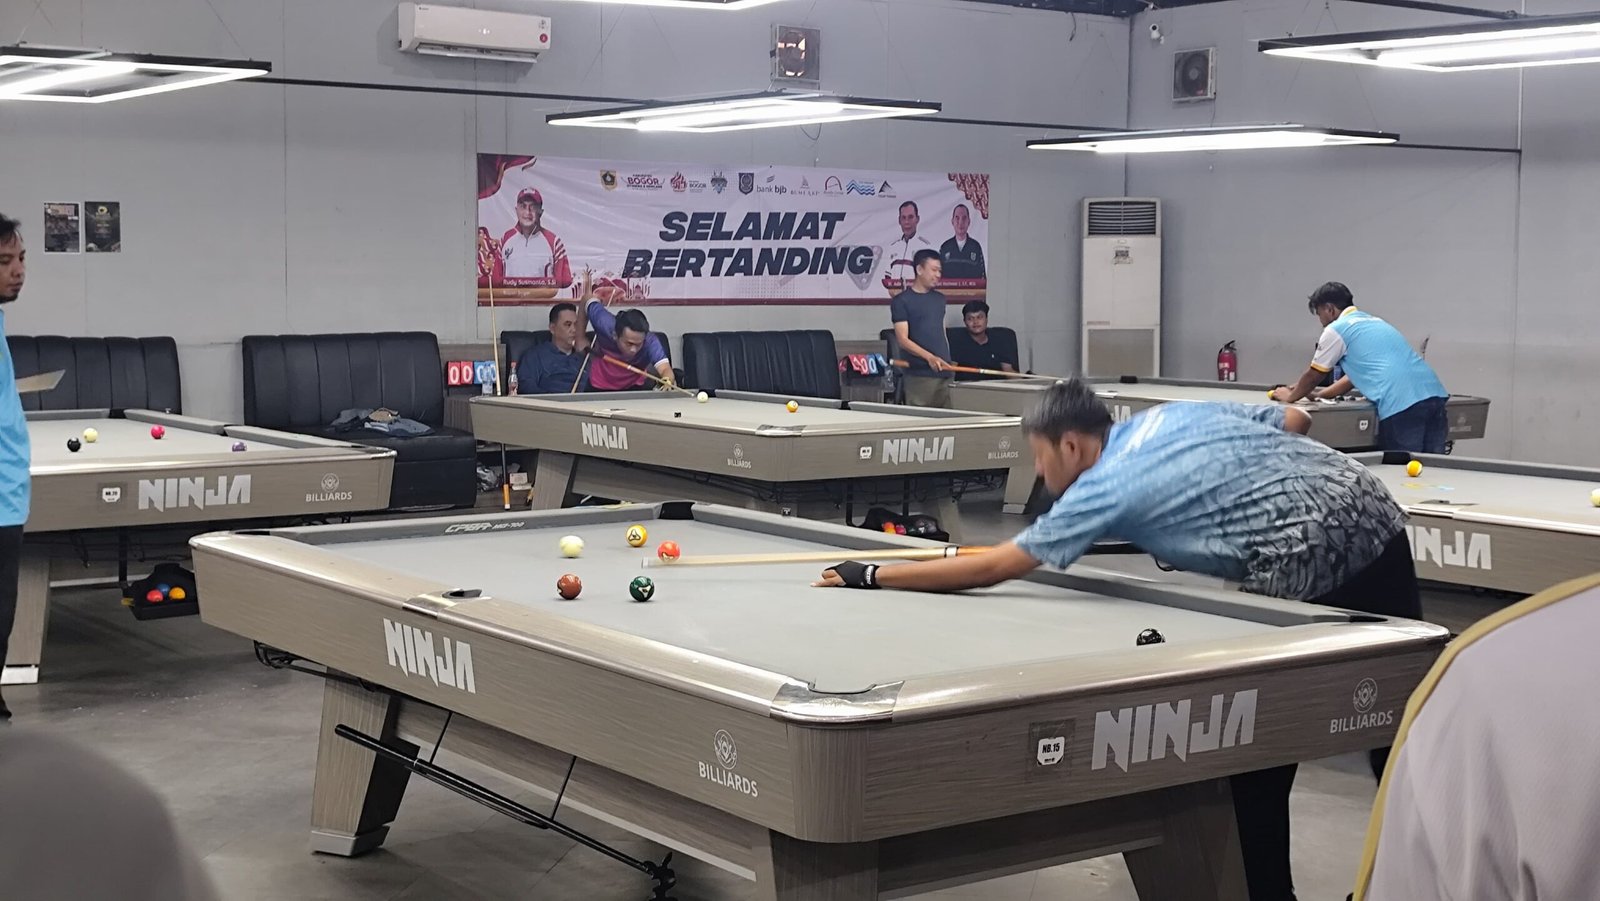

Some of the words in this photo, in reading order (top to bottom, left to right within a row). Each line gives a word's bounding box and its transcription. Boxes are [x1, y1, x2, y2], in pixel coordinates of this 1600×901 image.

[757, 185, 773, 193] bank
[775, 185, 787, 195] bjb
[659, 211, 846, 242] SELAMAT
[621, 246, 874, 279] BERTANDING
[581, 422, 628, 450] NINJA
[882, 436, 955, 465] NINJA
[988, 451, 1019, 460] BILLIARDS
[138, 474, 251, 512] NINJA
[305, 491, 352, 503] BILLIARDS
[383, 618, 476, 694] NINJA
[1091, 688, 1258, 773] NINJA
[1330, 710, 1394, 734] BILLIARDS
[1042, 743, 1060, 753] NB.15
[698, 760, 758, 798] BILLIARDS
